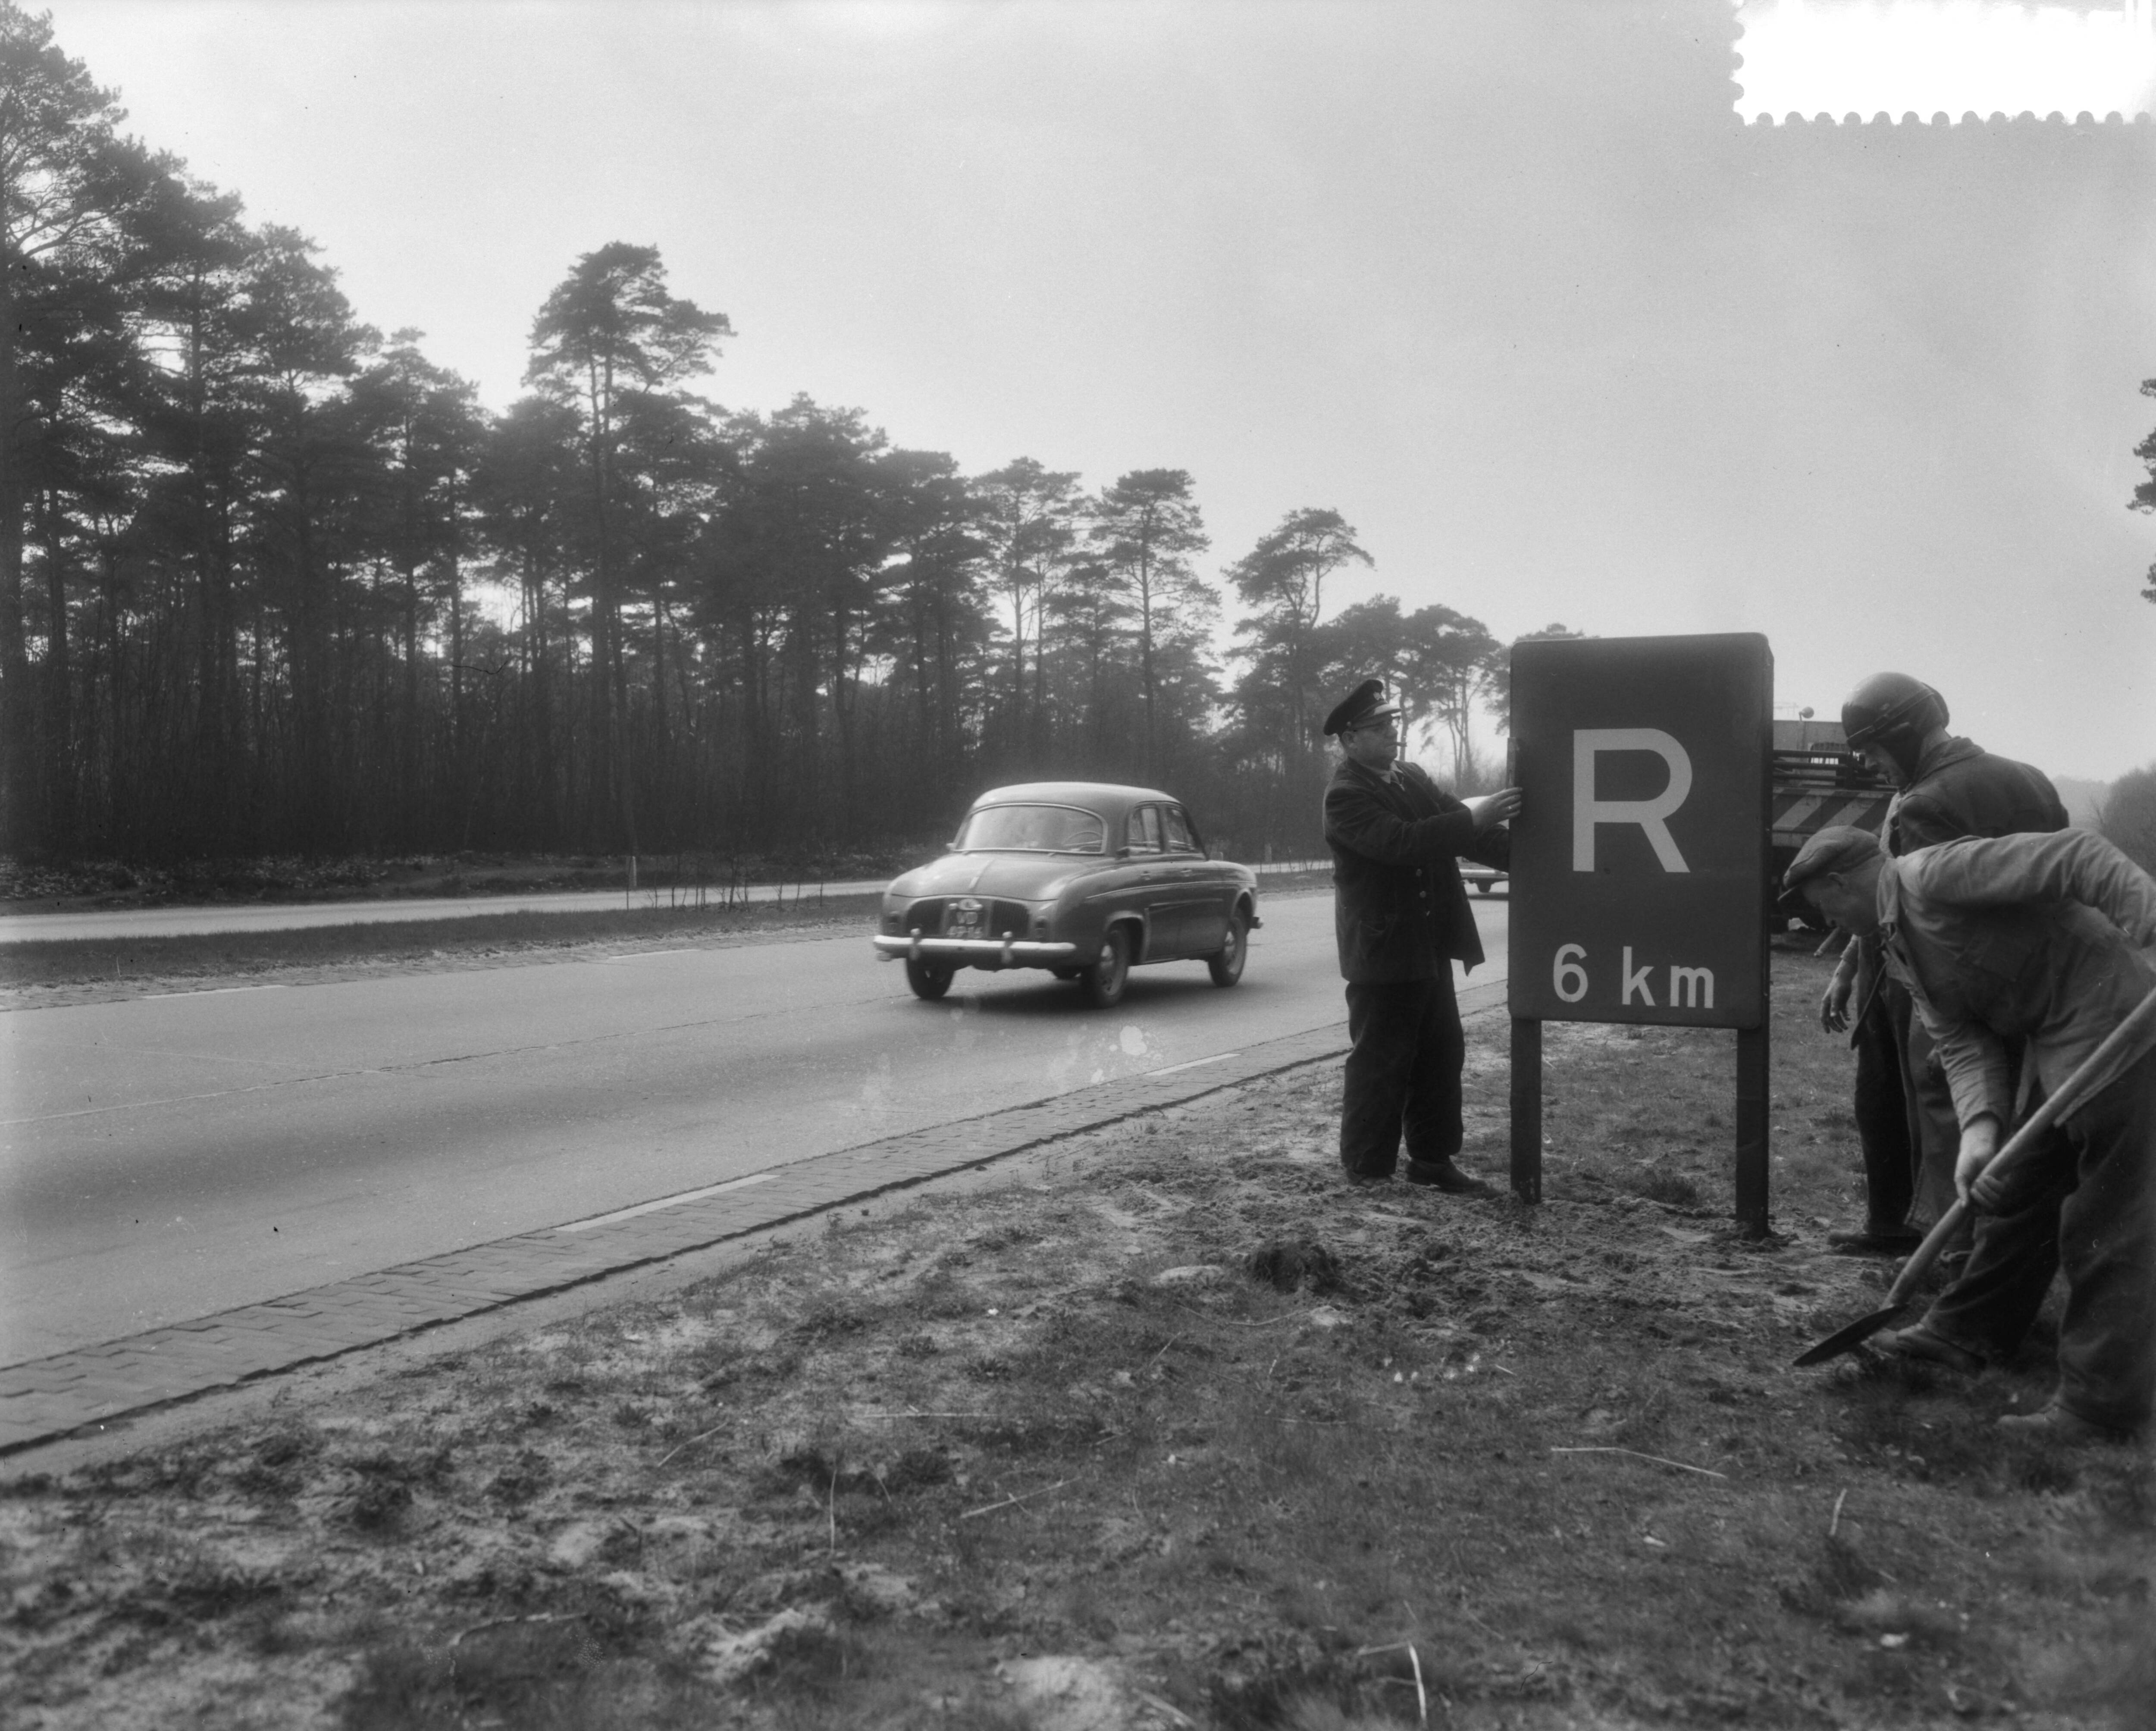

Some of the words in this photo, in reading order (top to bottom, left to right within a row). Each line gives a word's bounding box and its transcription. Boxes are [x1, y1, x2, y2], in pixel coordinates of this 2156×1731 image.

[1573, 728, 1692, 873] R
[1553, 943, 1588, 1003] 6
[1622, 946, 1714, 1009] km
